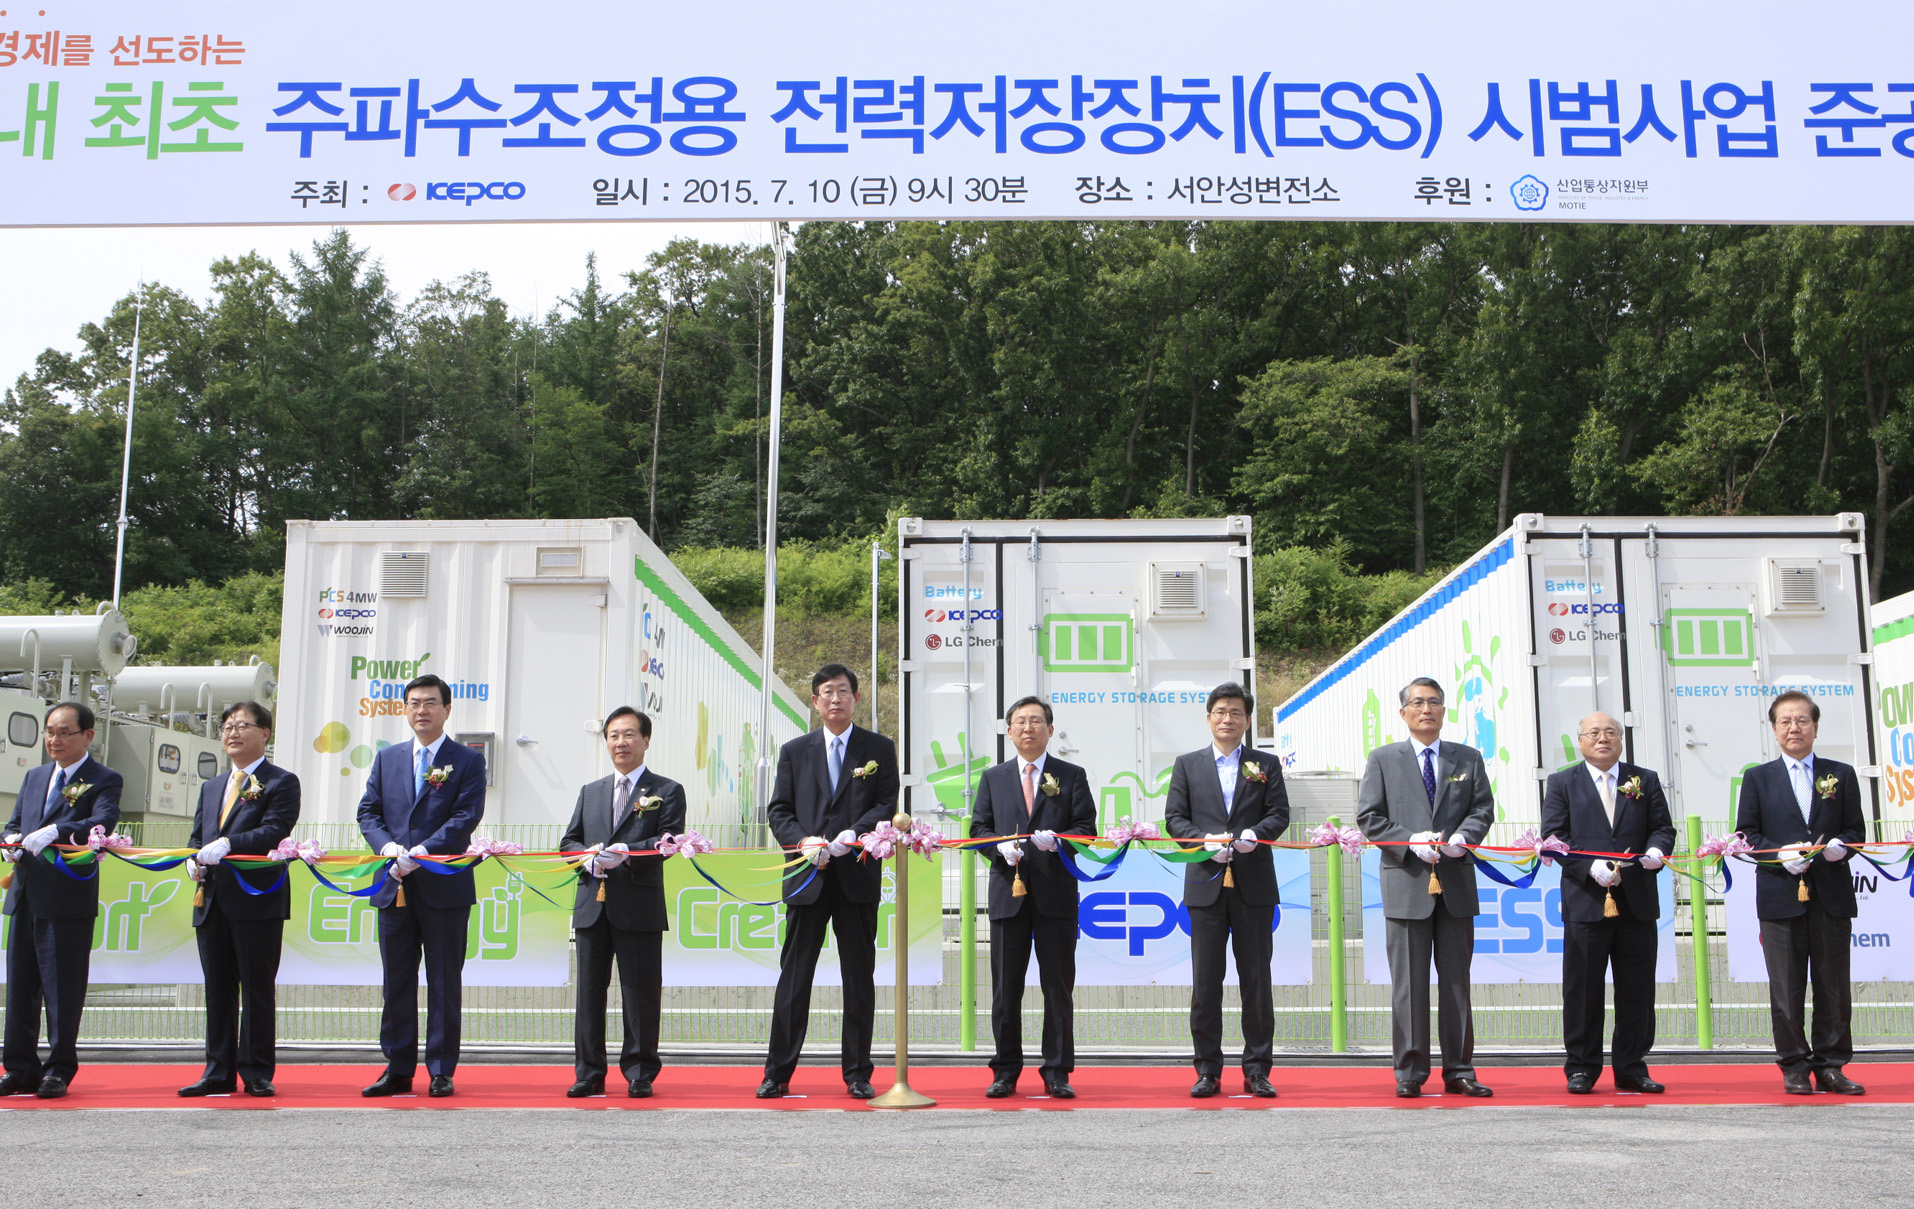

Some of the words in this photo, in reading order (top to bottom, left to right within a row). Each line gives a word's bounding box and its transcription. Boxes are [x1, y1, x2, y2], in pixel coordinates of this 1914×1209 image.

[0, 30, 95, 68] 경제를
[108, 34, 246, 67] 선도하는
[0, 81, 60, 161] 내
[84, 80, 244, 161] 최초
[265, 76, 747, 159] 주파수조정용
[769, 71, 1443, 159] 전력저장장치(ESS)
[1467, 78, 1779, 159] 시범사업
[290, 179, 348, 209] 주최
[425, 181, 527, 207] KEPCO
[592, 177, 648, 206] 일시
[682, 178, 759, 206] 2015.
[770, 179, 794, 206] 7.
[808, 178, 841, 204] 10
[850, 175, 898, 207] (금)
[907, 175, 953, 205] 9시
[964, 175, 1029, 204] 30분
[1074, 175, 1134, 205] 장소
[1167, 175, 1341, 205] 서안성변전소
[1413, 176, 1472, 206] 후원
[1556, 178, 1649, 194] 산업통상자원부
[1558, 202, 1586, 210] MOTIE
[319, 588, 345, 603] PCS
[346, 591, 378, 603] 4MW
[1545, 580, 1602, 594] Battey
[335, 608, 377, 620] KEPCO
[945, 636, 963, 647] LG
[1569, 630, 1586, 641] LG
[351, 655, 422, 680] Power
[370, 680, 488, 701] Conning
[1051, 692, 1106, 704] ENERGY
[1111, 692, 1175, 704] STORAGE
[1180, 692, 1212, 704] SYS
[1676, 685, 1729, 697] ENERGY
[1801, 684, 1855, 697] SYSTEM
[359, 698, 407, 718] Syste
